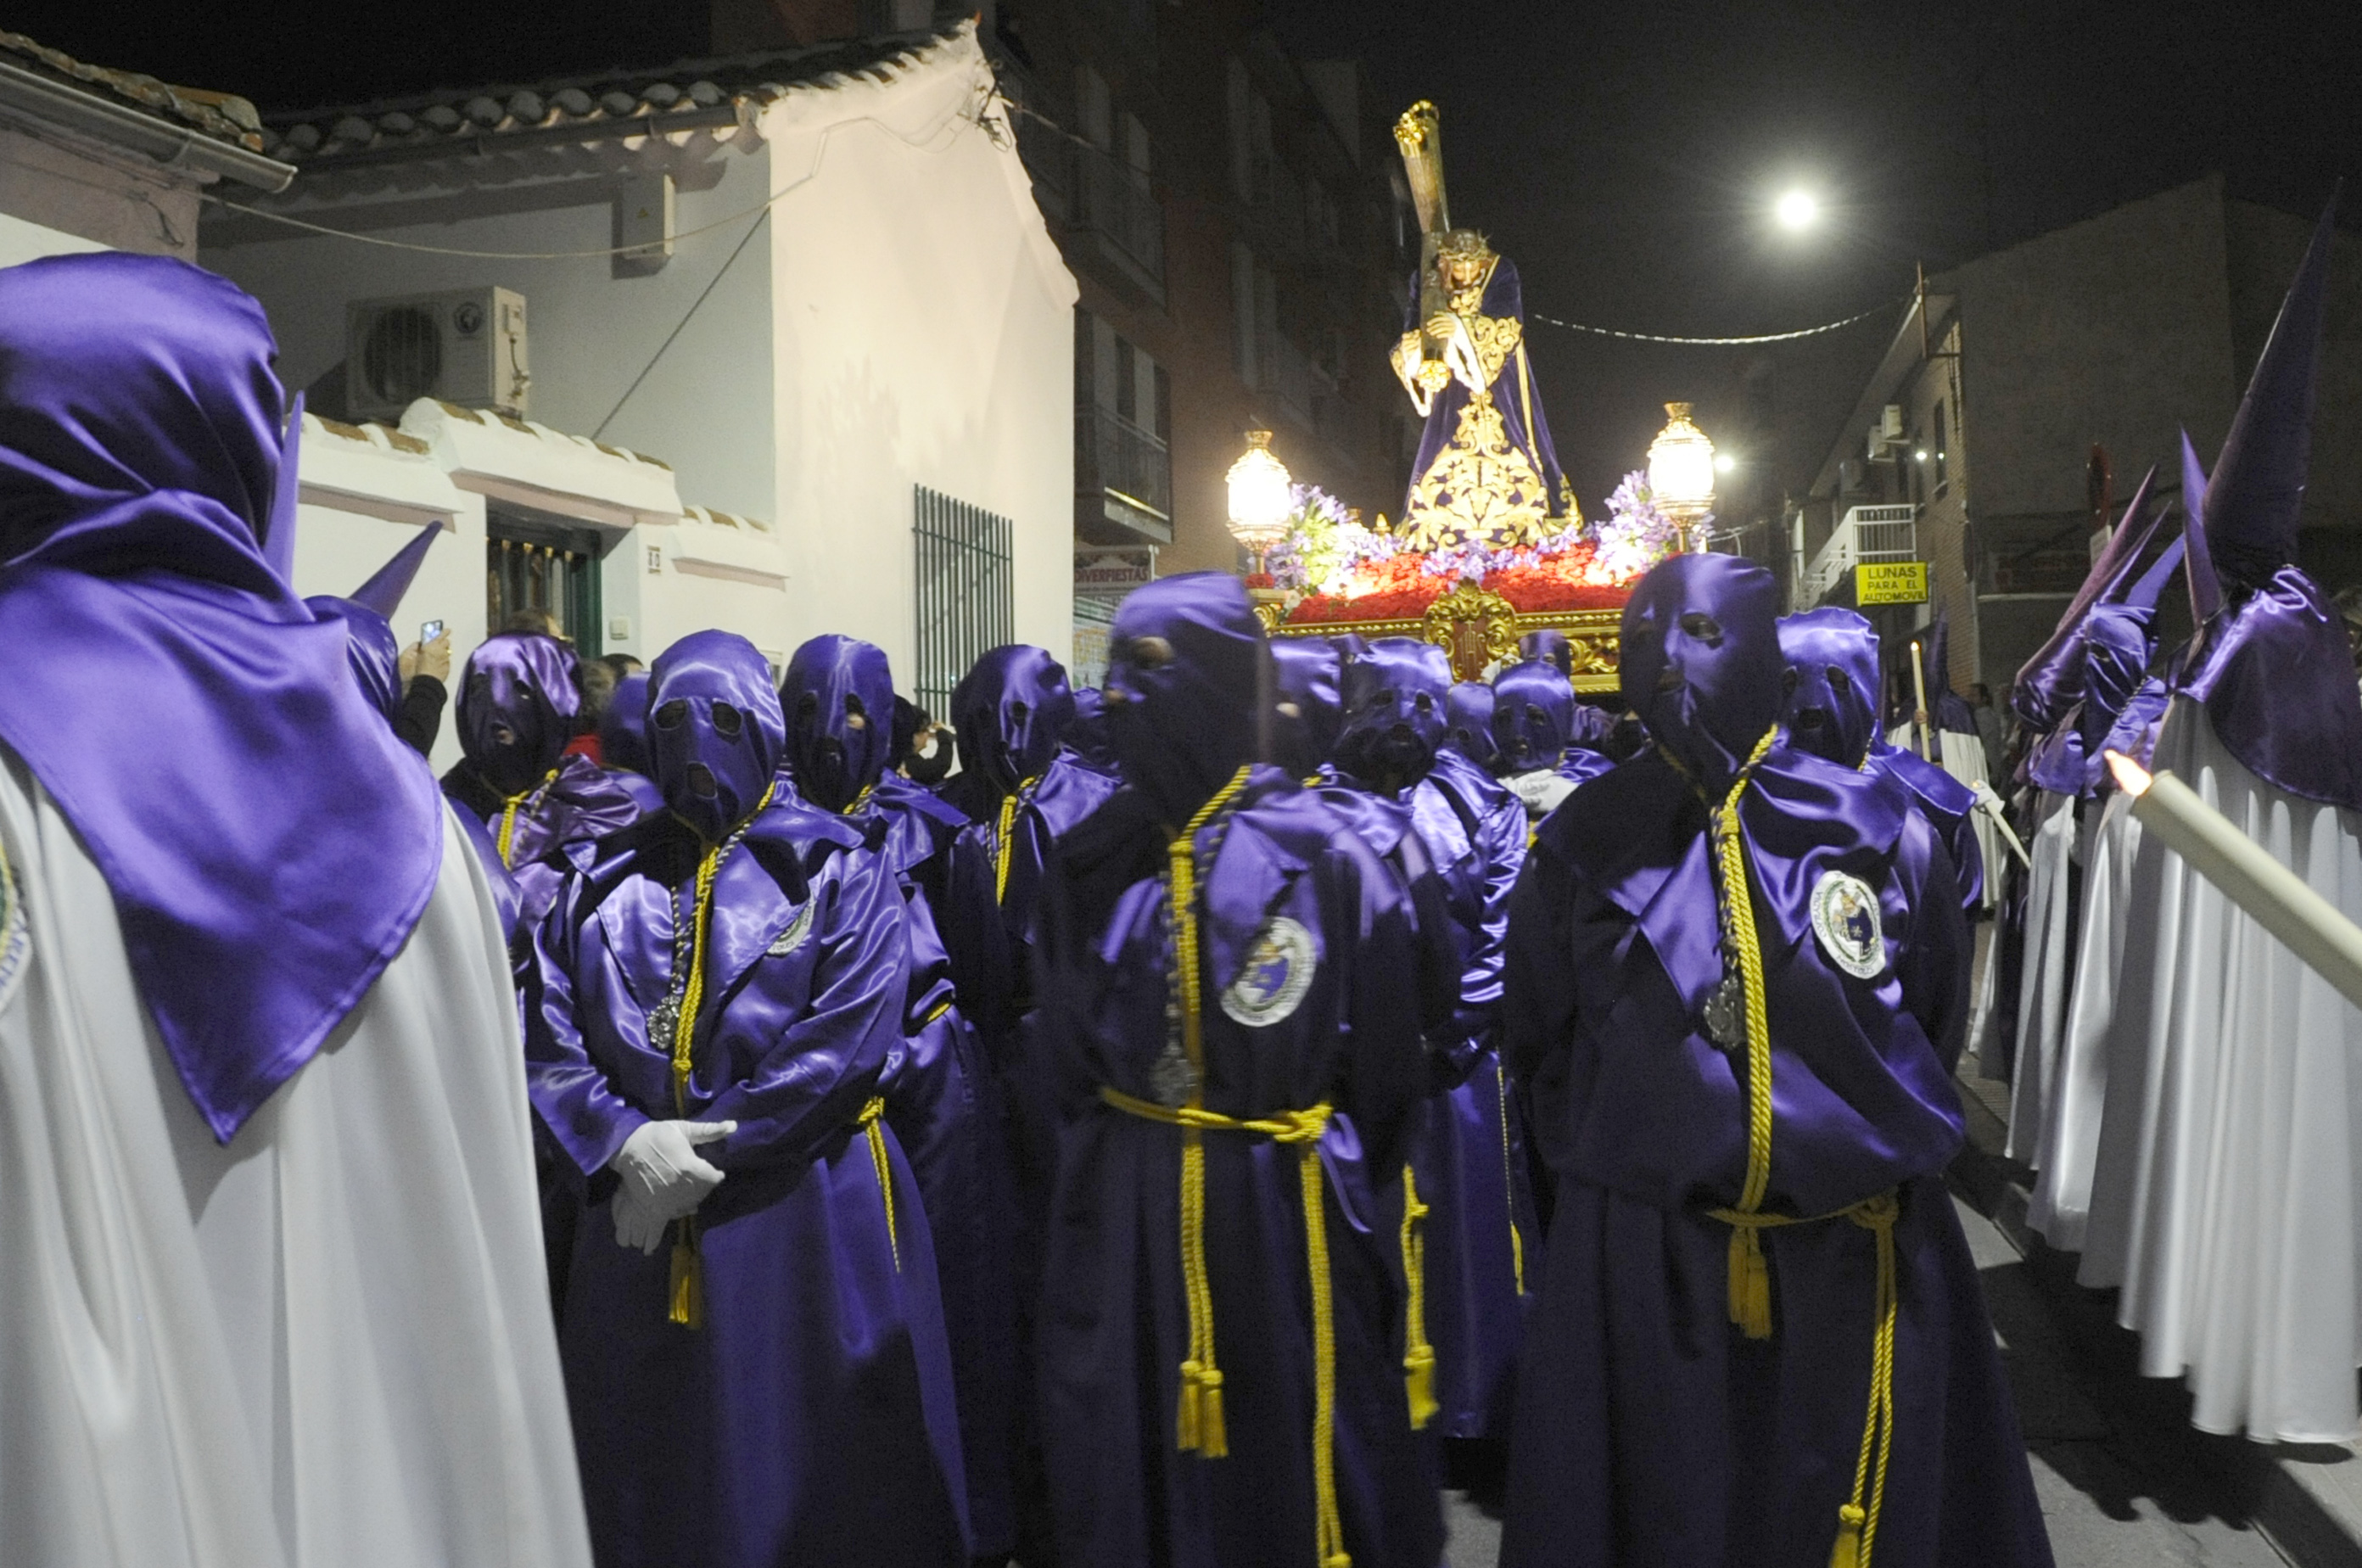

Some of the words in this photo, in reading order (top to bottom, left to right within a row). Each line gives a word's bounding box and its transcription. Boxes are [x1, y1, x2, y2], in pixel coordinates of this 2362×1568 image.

[1075, 568, 1148, 583] DIVERFIESTAS
[1868, 567, 1917, 579] LUNAS
[1867, 580, 1899, 590] PARA
[1906, 580, 1917, 589] EL
[1863, 591, 1925, 602] AUTOMOVIL
